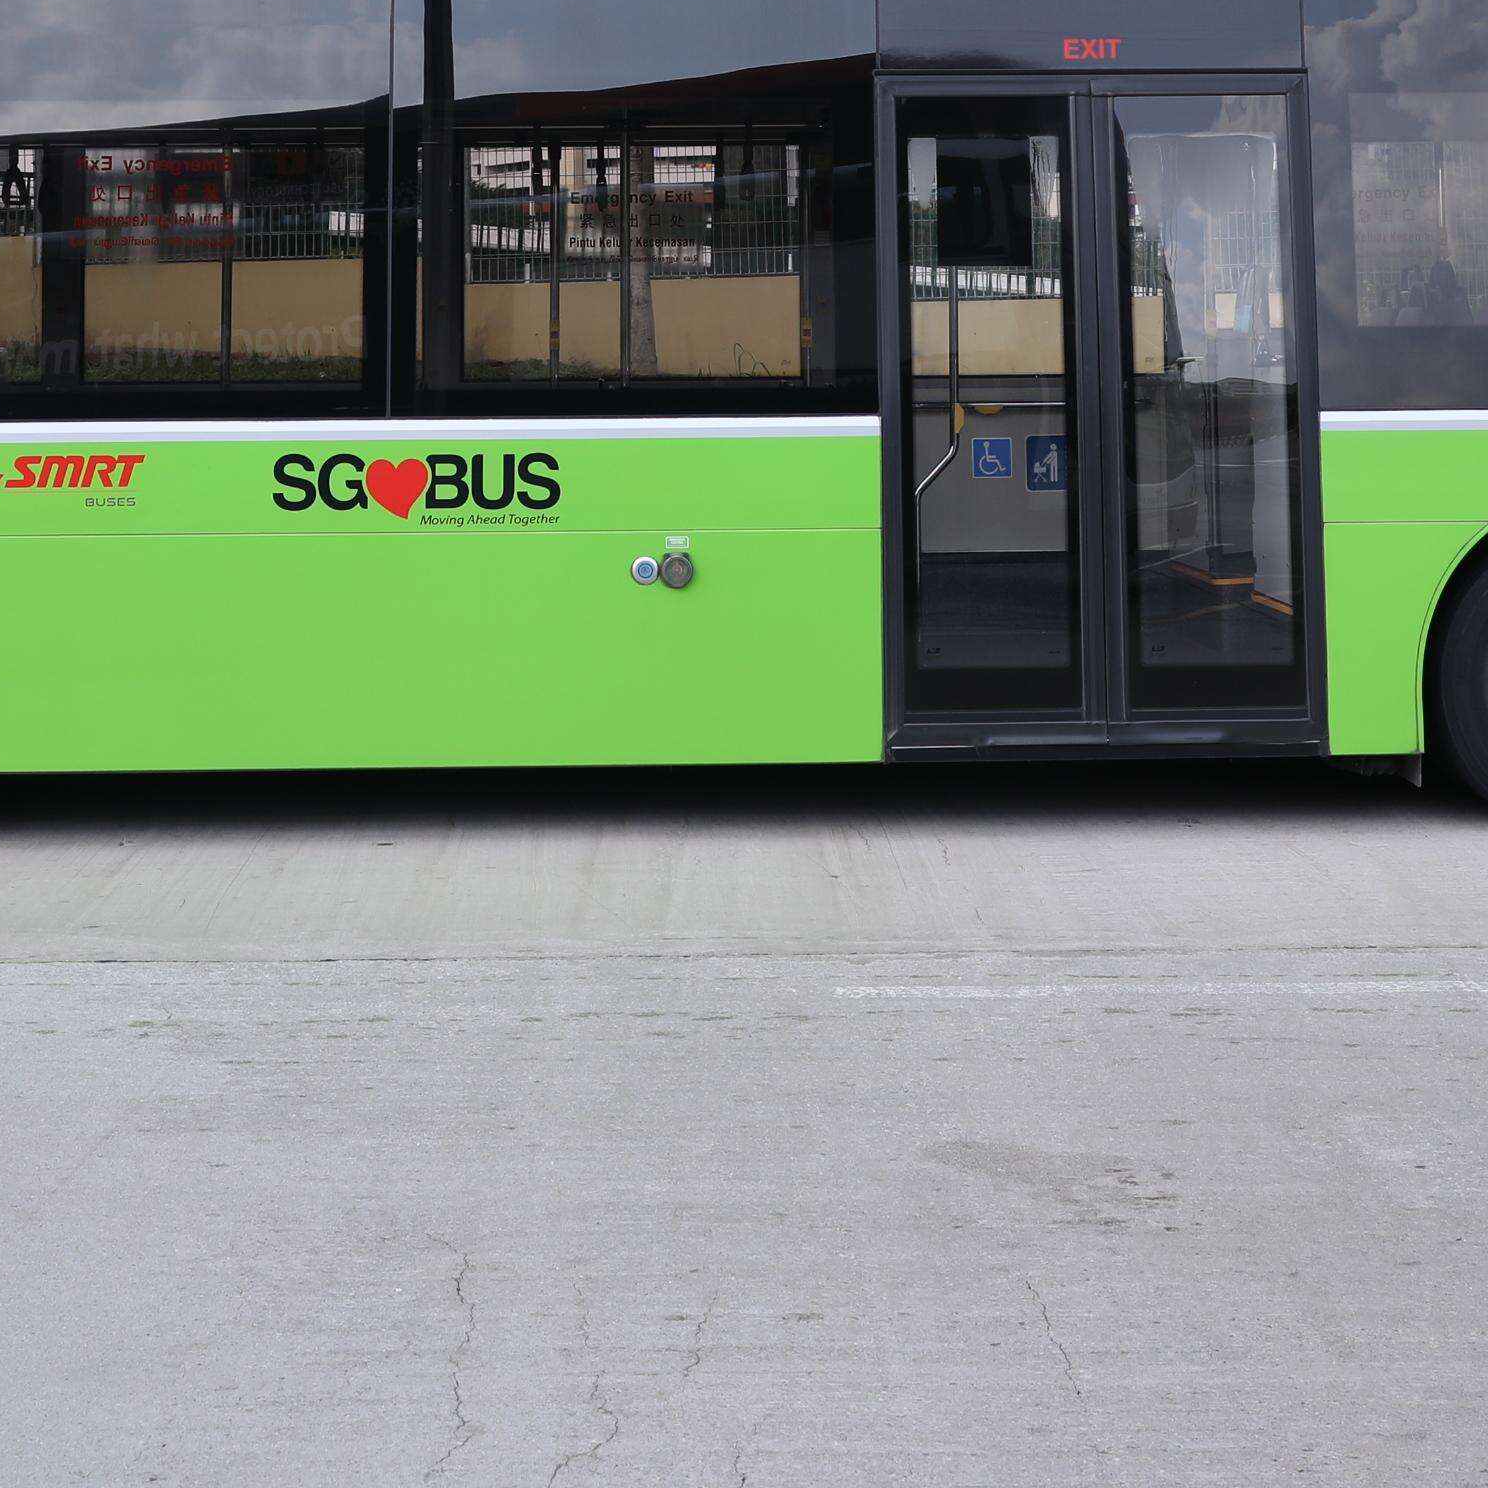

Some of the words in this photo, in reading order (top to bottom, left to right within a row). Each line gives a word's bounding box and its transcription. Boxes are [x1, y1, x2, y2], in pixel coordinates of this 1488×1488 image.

[1063, 37, 1121, 61] EXIT
[664, 190, 693, 204] Exit
[569, 236, 596, 248] Pintu
[599, 236, 632, 248] Kelur
[635, 236, 695, 248] Kecemasan
[4, 454, 146, 489] SMRT
[84, 497, 137, 508] BUSES
[420, 514, 465, 528] Moving
[467, 514, 506, 526] Ahead
[508, 513, 561, 527] Together
